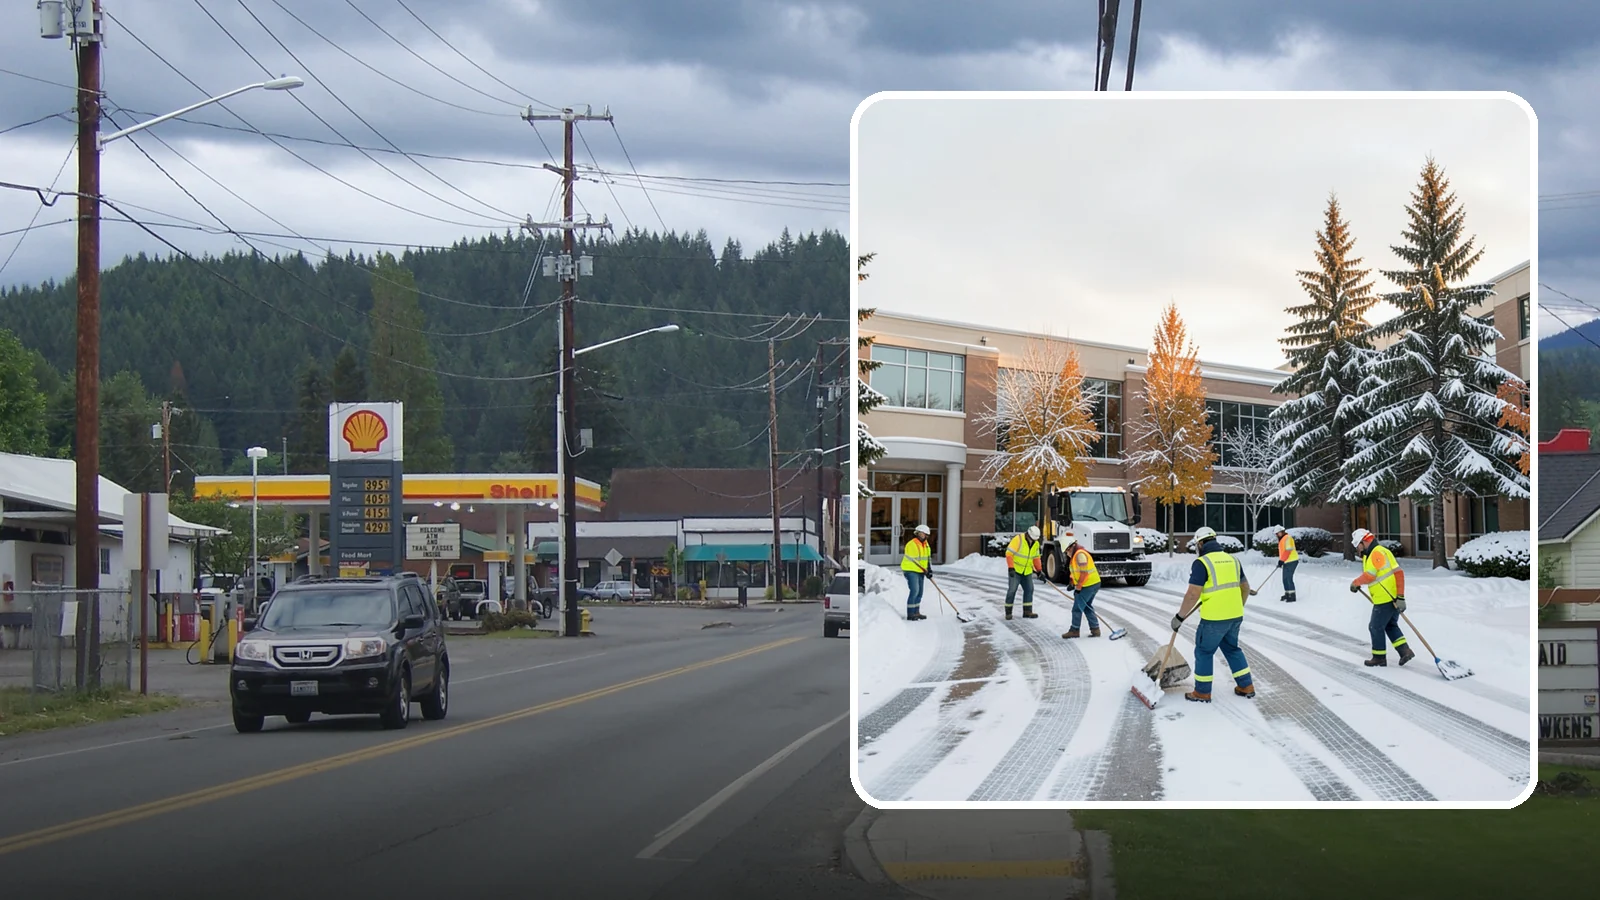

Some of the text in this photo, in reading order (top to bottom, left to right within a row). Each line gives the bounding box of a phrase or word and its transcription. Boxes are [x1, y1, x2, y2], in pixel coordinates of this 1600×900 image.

[366, 480, 383, 490] 395
[490, 484, 547, 499] Shell
[366, 494, 383, 504] 405
[366, 508, 383, 518] 415
[366, 522, 383, 532] 429
[1539, 643, 1567, 666] AID
